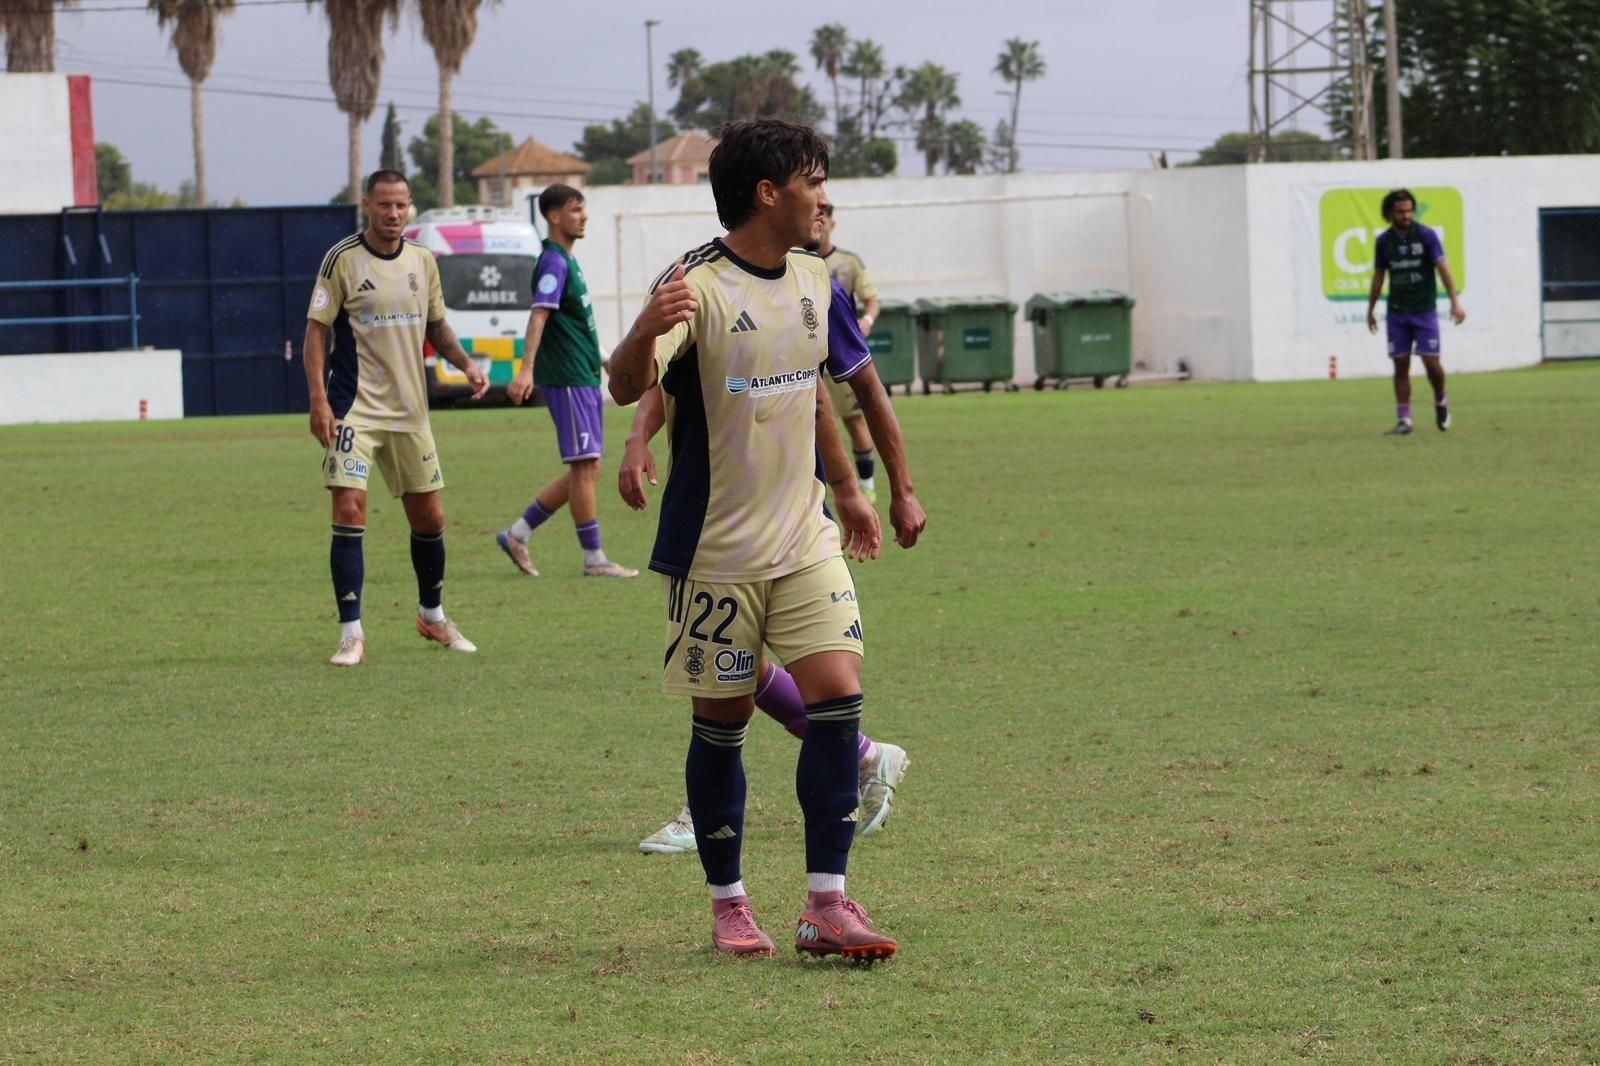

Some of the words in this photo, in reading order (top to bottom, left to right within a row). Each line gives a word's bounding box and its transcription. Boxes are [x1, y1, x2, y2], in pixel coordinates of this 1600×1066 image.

[466, 290, 518, 305] AMBEX
[751, 374, 795, 389] ATLANTIC
[336, 424, 355, 453] 18
[580, 432, 590, 450] 7
[343, 457, 367, 475] Olin
[688, 590, 739, 646] 22
[715, 649, 755, 672] Olin
